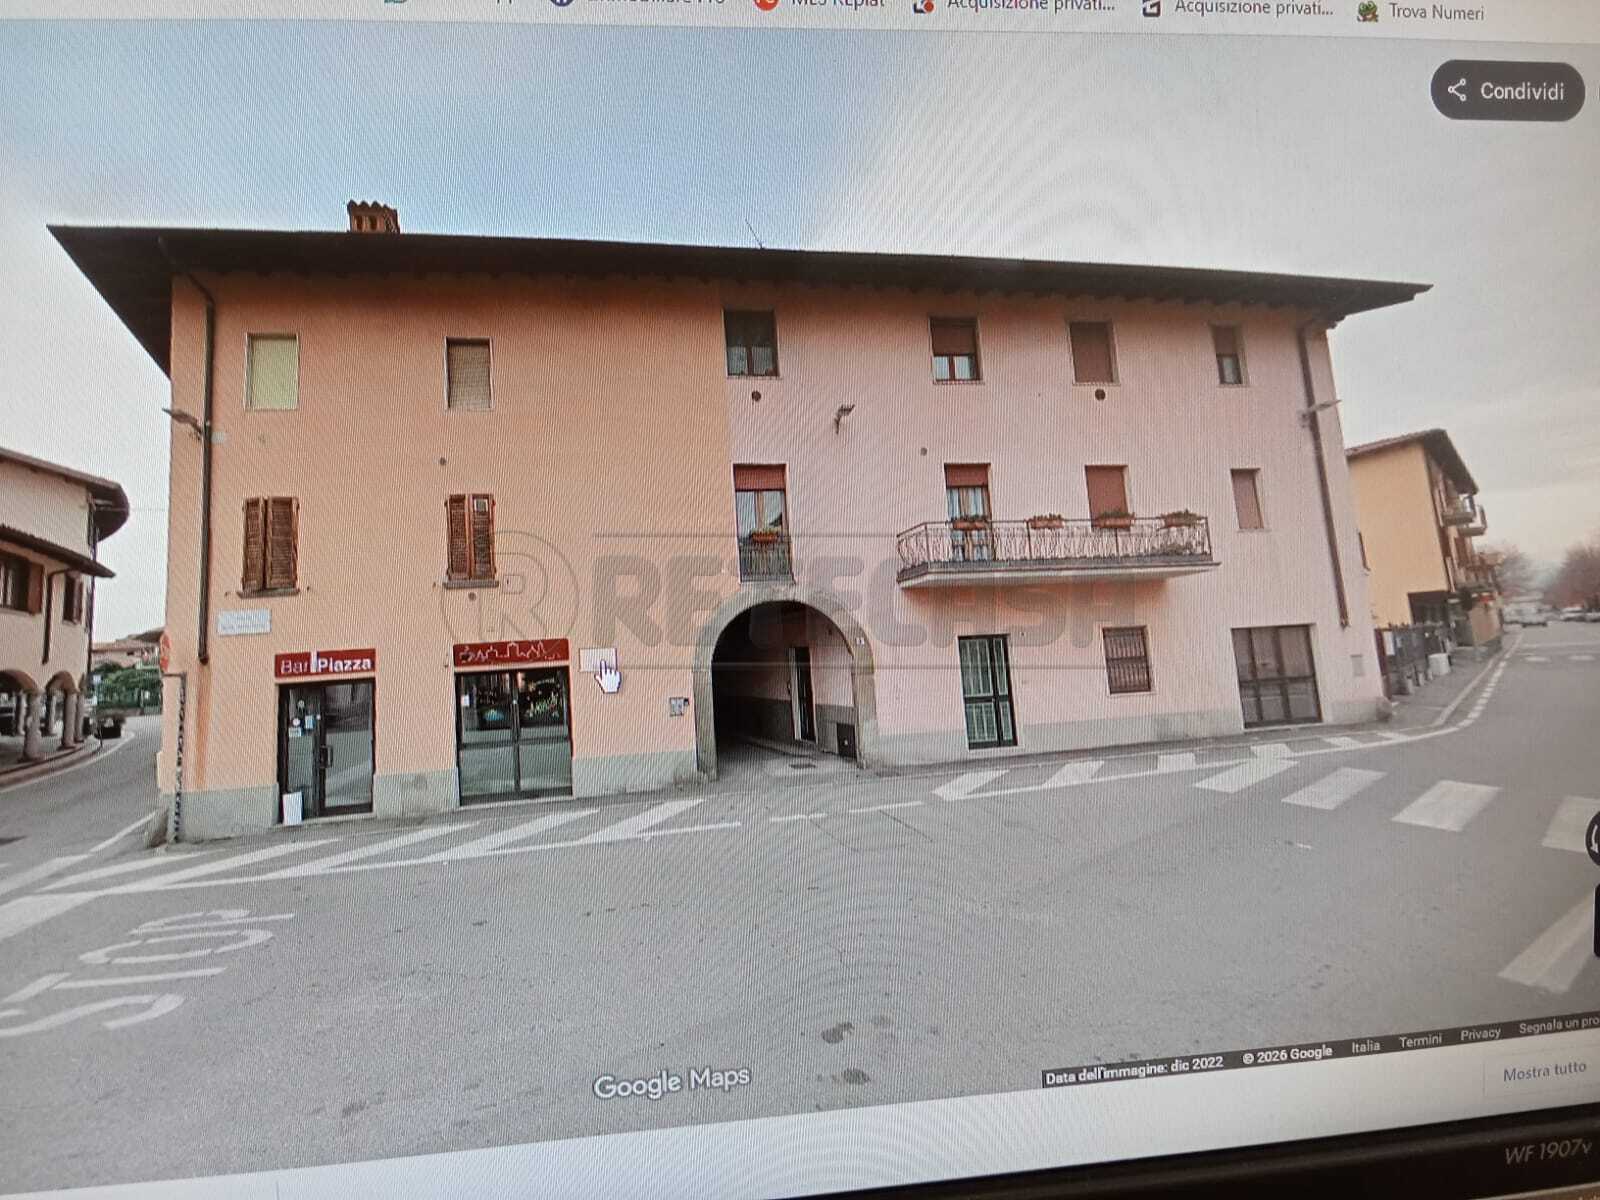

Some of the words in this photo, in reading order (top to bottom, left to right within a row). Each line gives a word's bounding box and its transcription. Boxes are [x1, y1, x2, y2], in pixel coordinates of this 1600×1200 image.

[947, 0, 1048, 13] Acquisizione
[1174, 0, 1271, 16] Acquisizione
[1389, 3, 1427, 19] Trova
[1432, 5, 1485, 21] Numeri
[1480, 81, 1565, 101] Condividi
[280, 659, 309, 674] Bar
[317, 657, 372, 673] Piazza
[1045, 1071, 1076, 1085] Data
[1078, 1063, 1168, 1081] dell'immagine:
[1170, 1058, 1190, 1072] dic
[1192, 1055, 1225, 1070] 2022
[1257, 1050, 1288, 1064] 2026
[1290, 1044, 1333, 1060] Google
[1351, 1039, 1381, 1054] Italia
[1399, 1032, 1443, 1049] Termini
[1460, 1027, 1501, 1042] Privacy
[1519, 1018, 1563, 1034] Segnala
[1565, 1019, 1580, 1029] un
[1503, 1067, 1550, 1082] Mostra
[1554, 1060, 1587, 1076] tutto
[594, 1069, 682, 1100] Google
[689, 1067, 751, 1091] Maps
[1505, 1144, 1536, 1165] WF
[1540, 1138, 1593, 1161] 1907v
